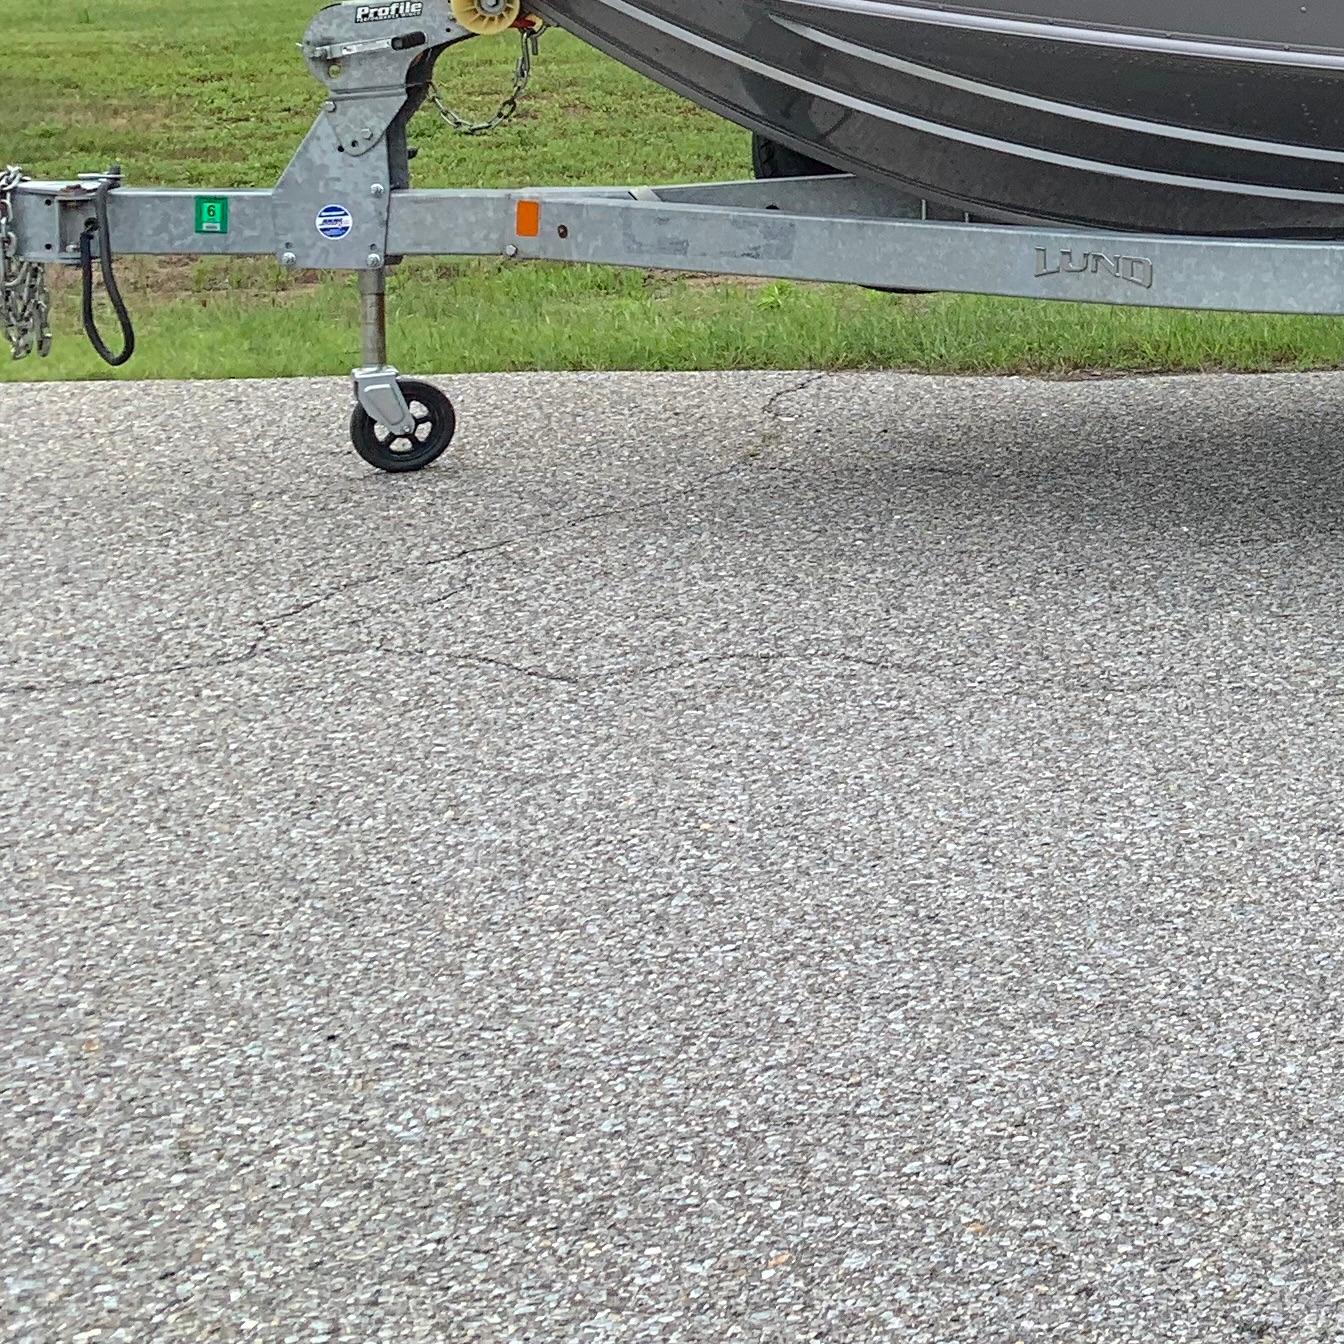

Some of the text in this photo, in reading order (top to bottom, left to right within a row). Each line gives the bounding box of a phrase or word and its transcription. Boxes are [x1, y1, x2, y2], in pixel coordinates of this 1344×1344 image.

[356, 0, 423, 19] Profile
[207, 204, 217, 218] 6
[1033, 245, 1153, 290] LUND
